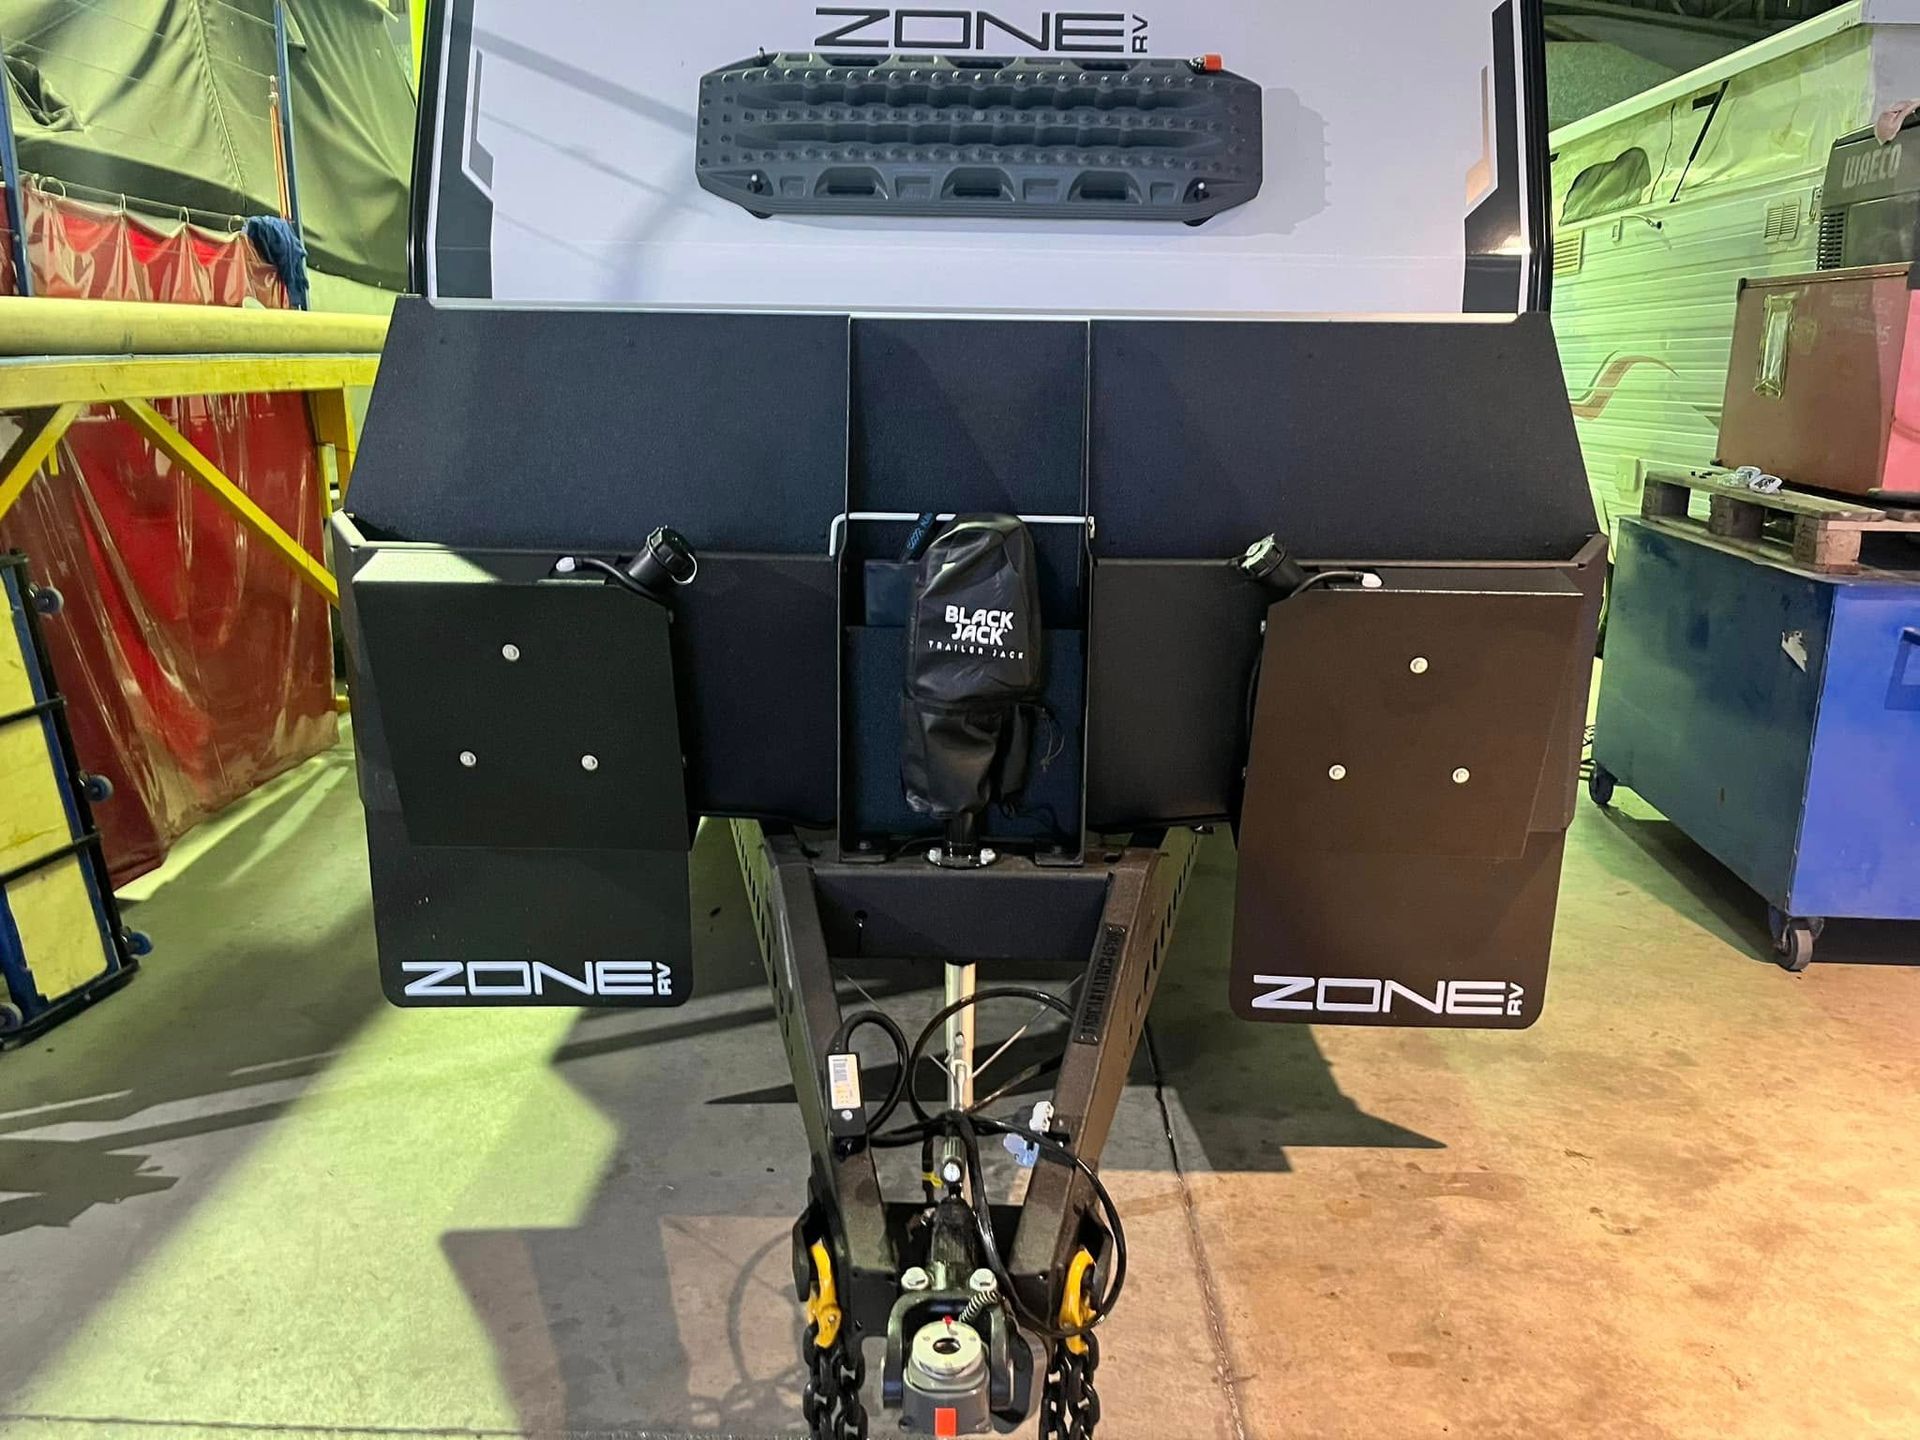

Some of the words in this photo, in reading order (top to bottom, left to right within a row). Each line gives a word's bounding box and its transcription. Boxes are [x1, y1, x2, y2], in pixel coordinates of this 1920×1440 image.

[814, 7, 1125, 53] ZONE
[1131, 13, 1148, 53] RV
[1842, 143, 1902, 189] WAECO
[944, 604, 1014, 630] BLACK
[951, 622, 1004, 646] JACK
[928, 640, 984, 655] TRAILER
[992, 647, 1024, 660] JACK
[401, 960, 654, 996] ZONE
[655, 961, 673, 996] RV
[1251, 974, 1506, 1016] ZONE
[1507, 981, 1525, 1016] RV
